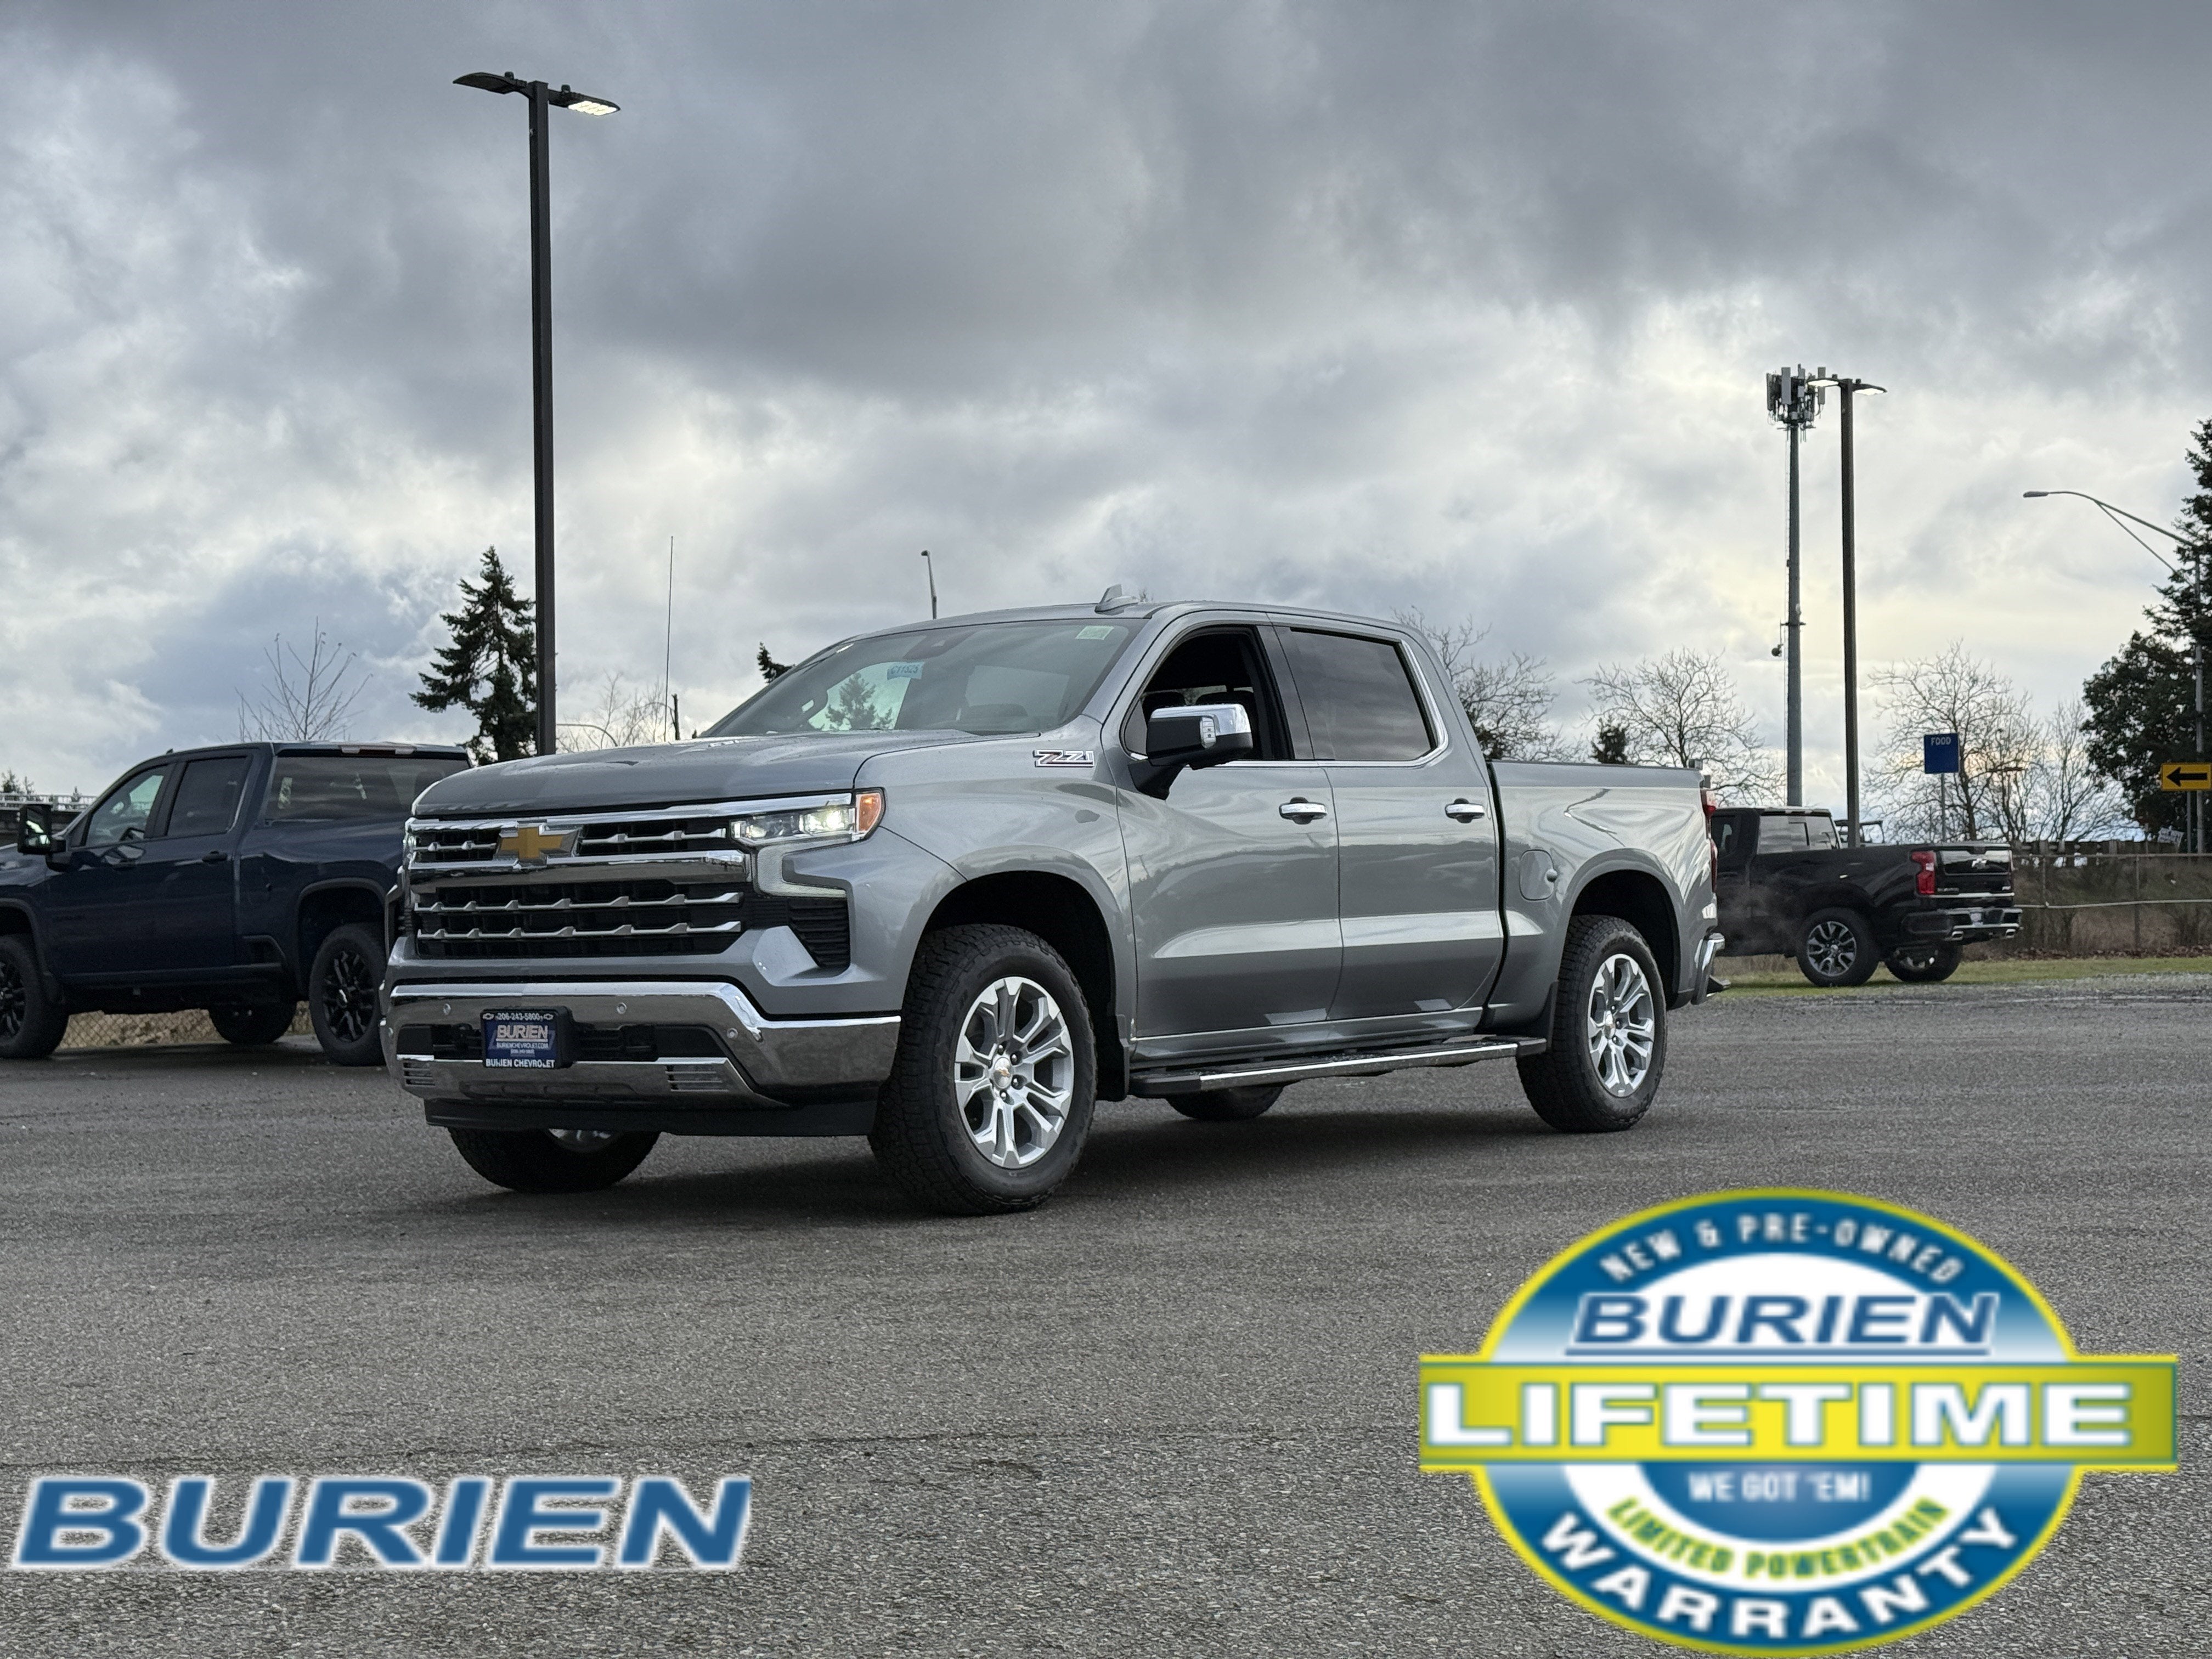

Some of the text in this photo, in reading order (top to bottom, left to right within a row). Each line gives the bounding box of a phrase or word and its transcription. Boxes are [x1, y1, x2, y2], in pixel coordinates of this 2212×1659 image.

[1931, 736, 1951, 746] FOOD
[1032, 749, 1095, 768] Z71
[497, 1024, 548, 1039] BURIEN
